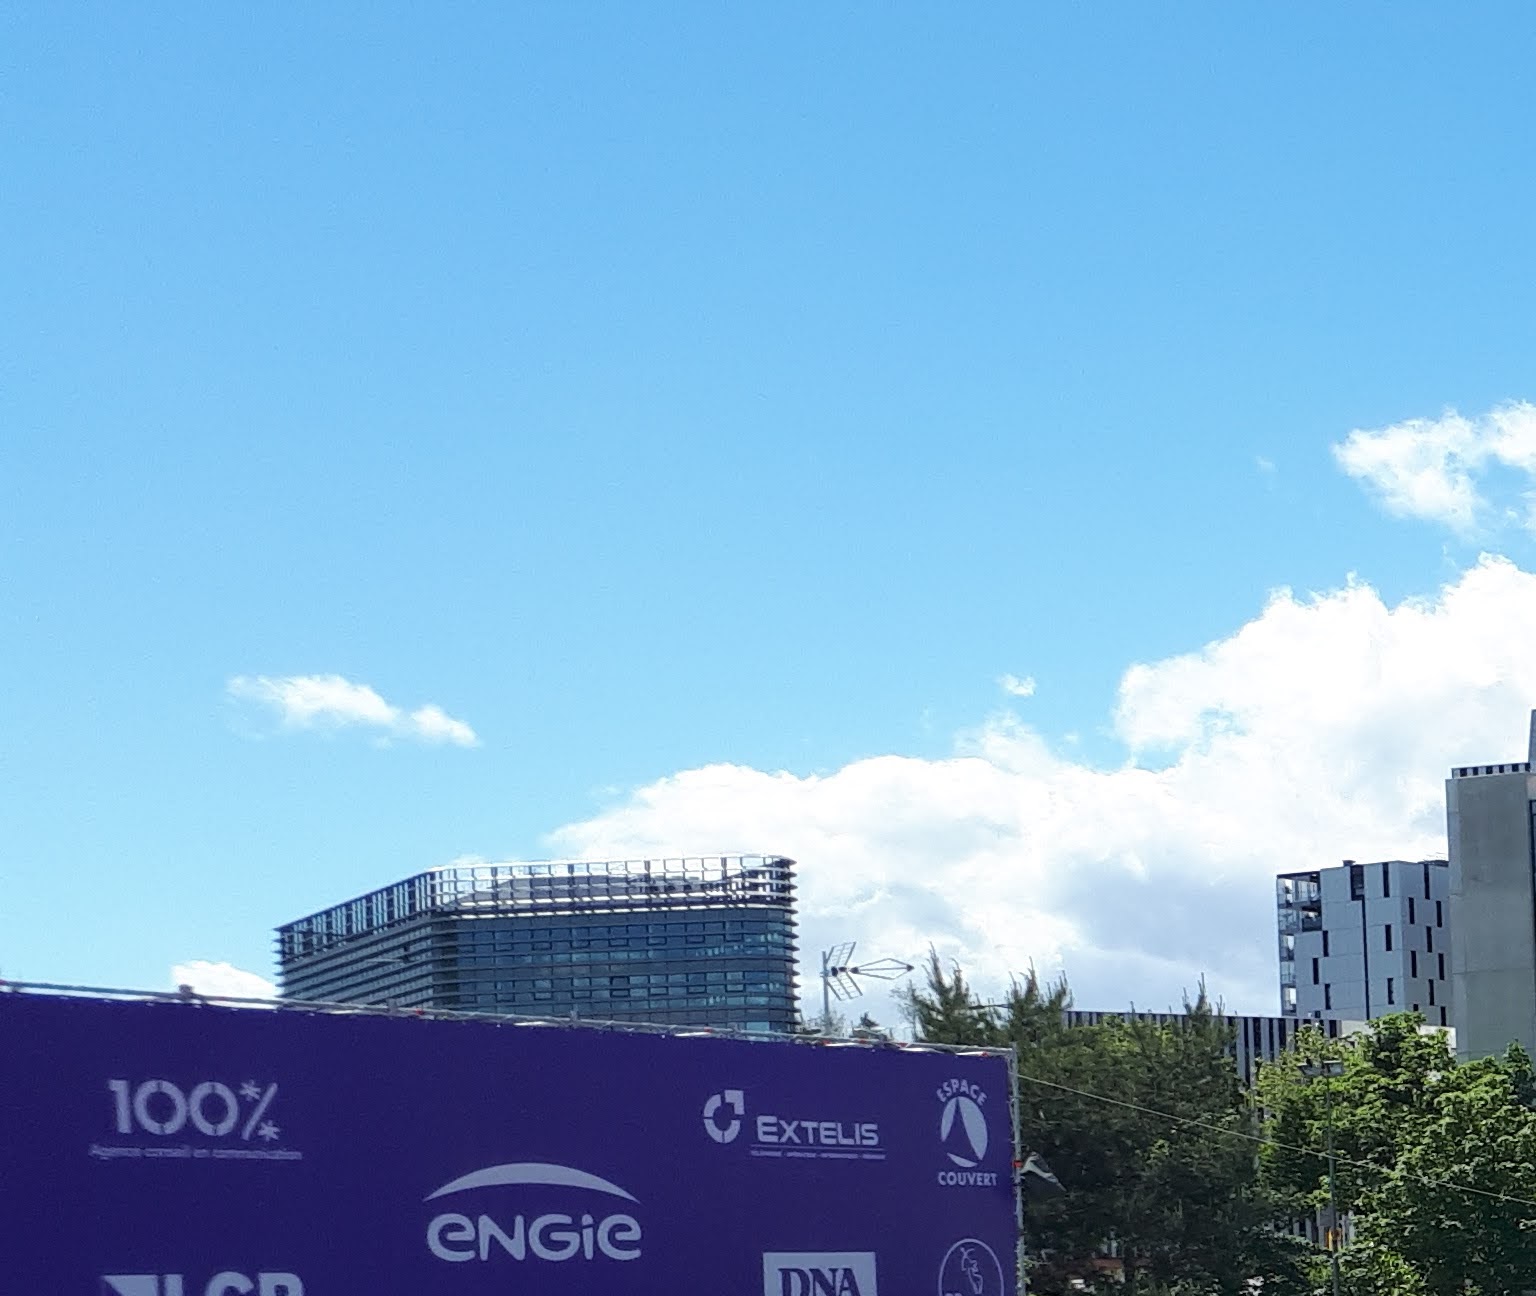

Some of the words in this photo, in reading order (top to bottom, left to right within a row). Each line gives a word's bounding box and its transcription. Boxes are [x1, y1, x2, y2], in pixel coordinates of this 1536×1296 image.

[936, 1079, 988, 1105] ESPACE
[756, 1115, 879, 1146] EXTELIS
[938, 1171, 998, 1186] COUVERT
